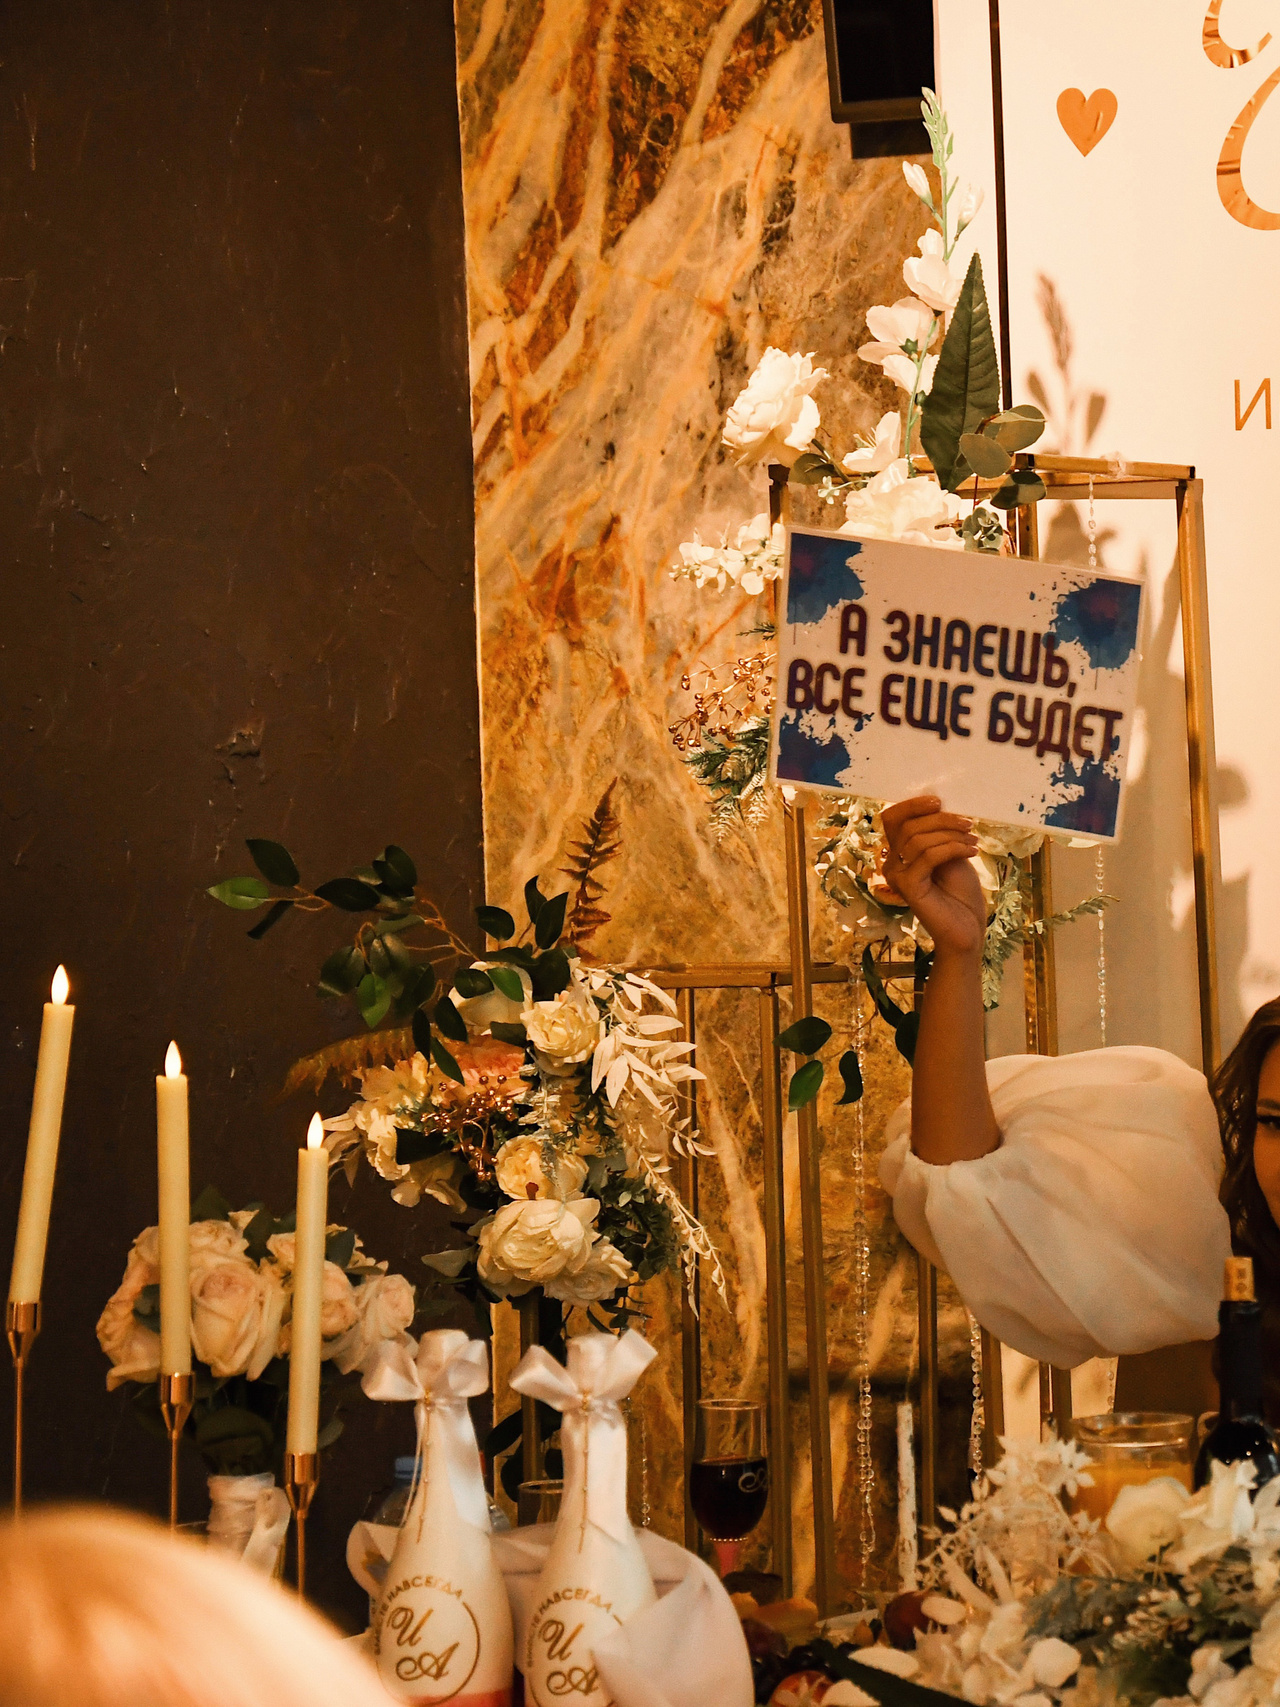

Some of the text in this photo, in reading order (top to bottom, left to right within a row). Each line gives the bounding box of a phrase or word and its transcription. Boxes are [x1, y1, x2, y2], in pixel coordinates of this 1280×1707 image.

[839, 603, 1077, 698] А ЗНАЕШЬ,
[786, 658, 1123, 763] ВСЕ ЕЩЕ БУДЕТ
